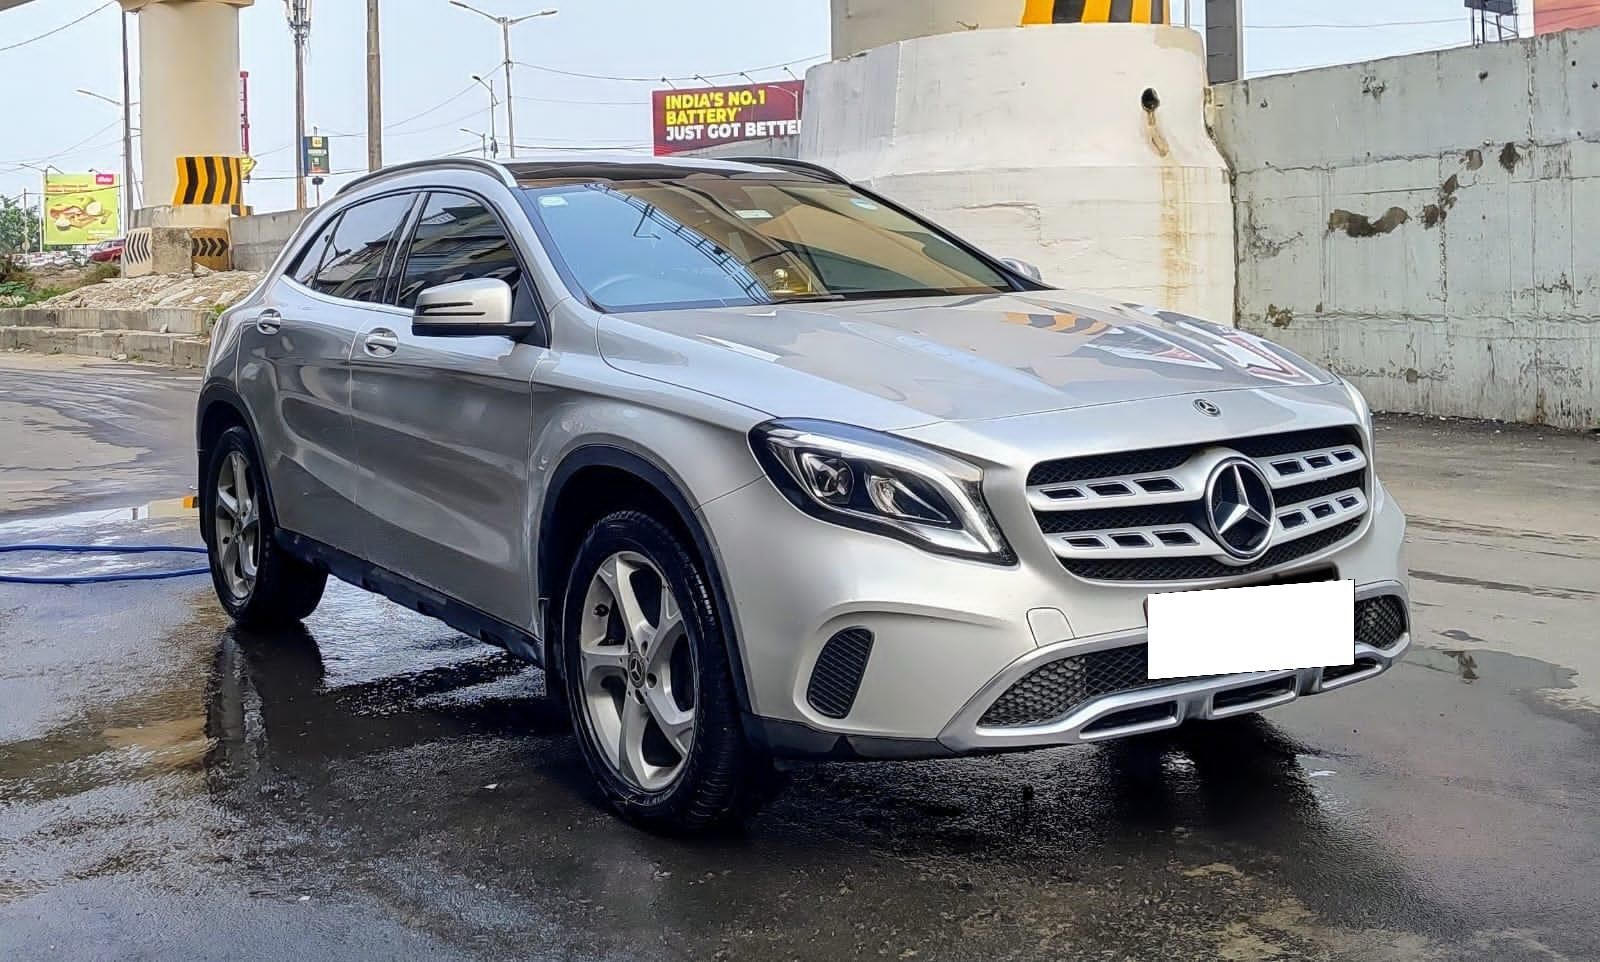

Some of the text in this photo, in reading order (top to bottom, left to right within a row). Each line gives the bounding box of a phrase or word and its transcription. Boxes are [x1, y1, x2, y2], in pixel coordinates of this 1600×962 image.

[665, 90, 766, 110] INDIA'S NO.1
[666, 125, 705, 141] JUST
[707, 123, 741, 139] GOT
